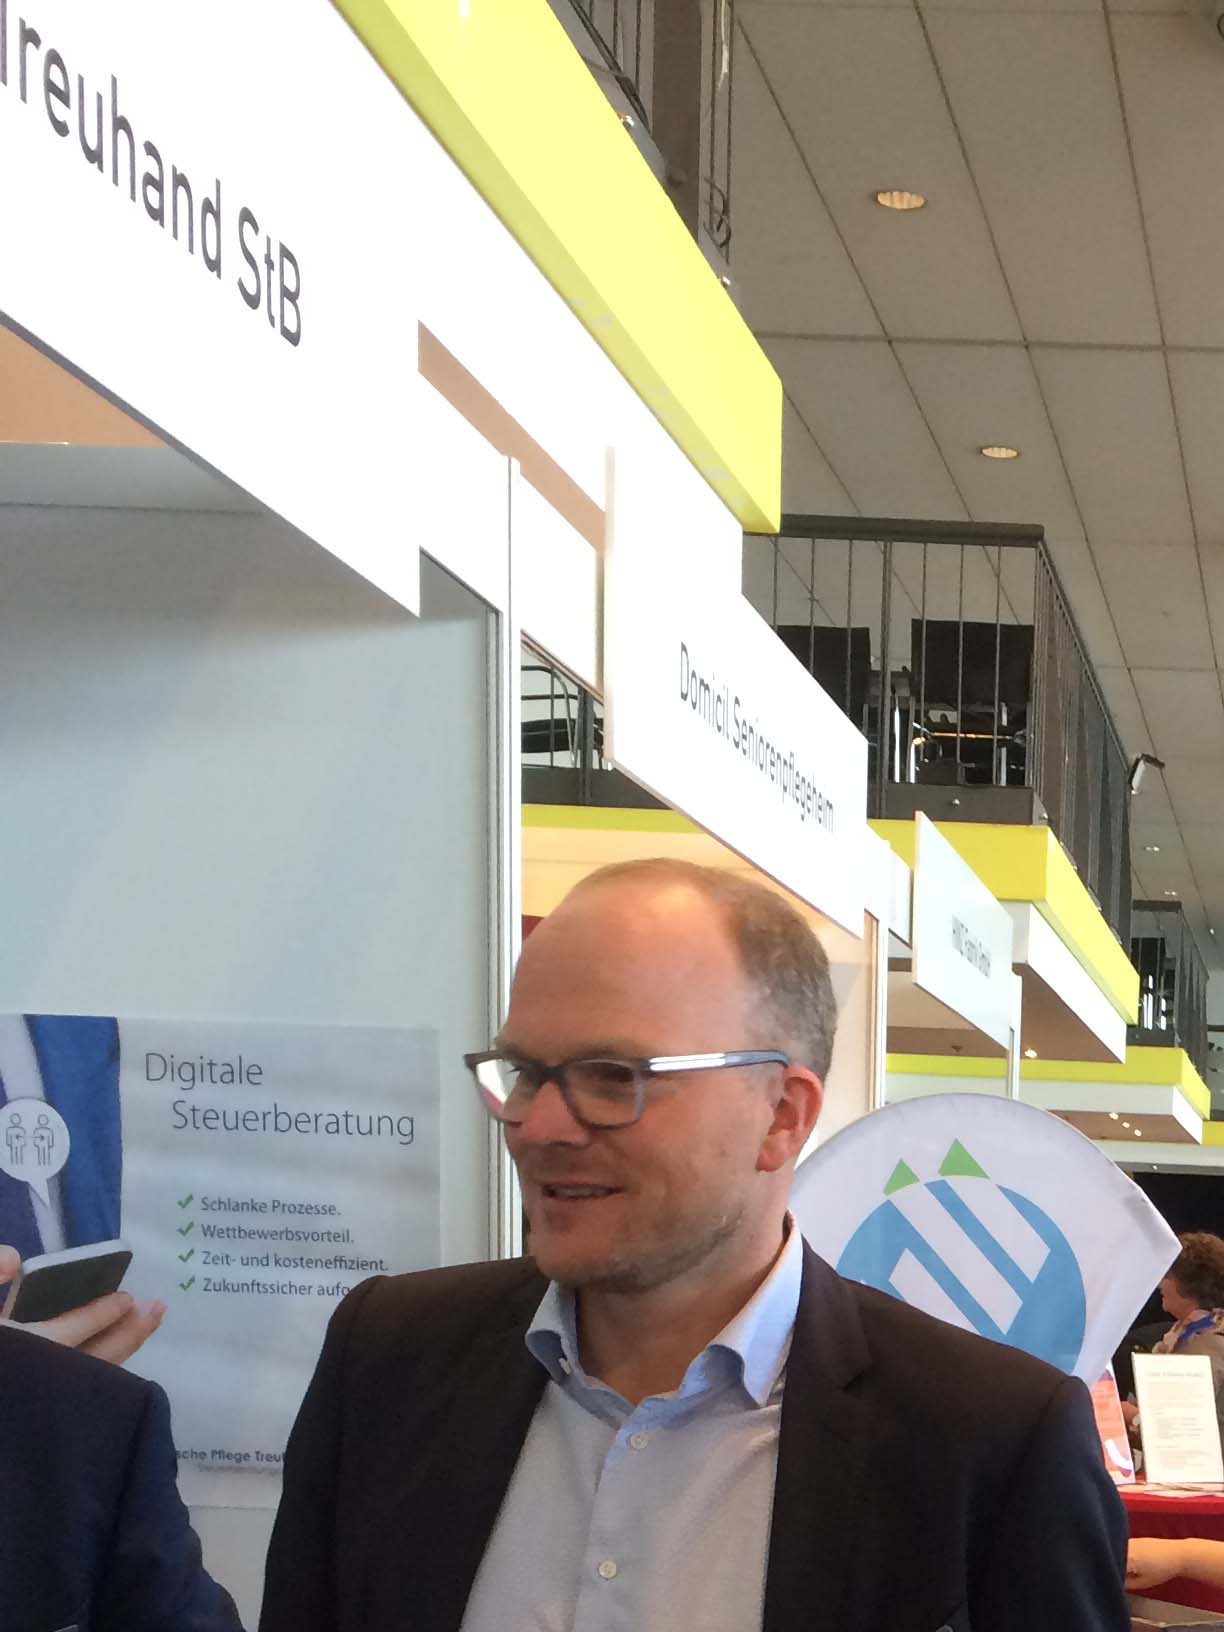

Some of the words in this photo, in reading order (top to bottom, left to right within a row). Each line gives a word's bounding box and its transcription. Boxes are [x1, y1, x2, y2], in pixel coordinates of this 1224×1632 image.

[237, 206, 302, 348] StB
[680, 641, 730, 741] Domicil
[732, 695, 834, 833] Seniorenpflegeheim
[144, 1052, 264, 1092] Digitale
[171, 1099, 416, 1146] Steuerberatung
[201, 1196, 269, 1215] Schlanke
[272, 1199, 342, 1216] Prozesse.
[201, 1223, 355, 1244] Wettbewerbsvorteil.
[202, 1251, 237, 1267] Zeit-
[240, 1253, 270, 1267] und
[274, 1253, 389, 1272] kosteneffizient.
[202, 1277, 314, 1297] Zukunftssicher
[211, 1449, 251, 1464] Pflege
[255, 1450, 286, 1463] Treu
